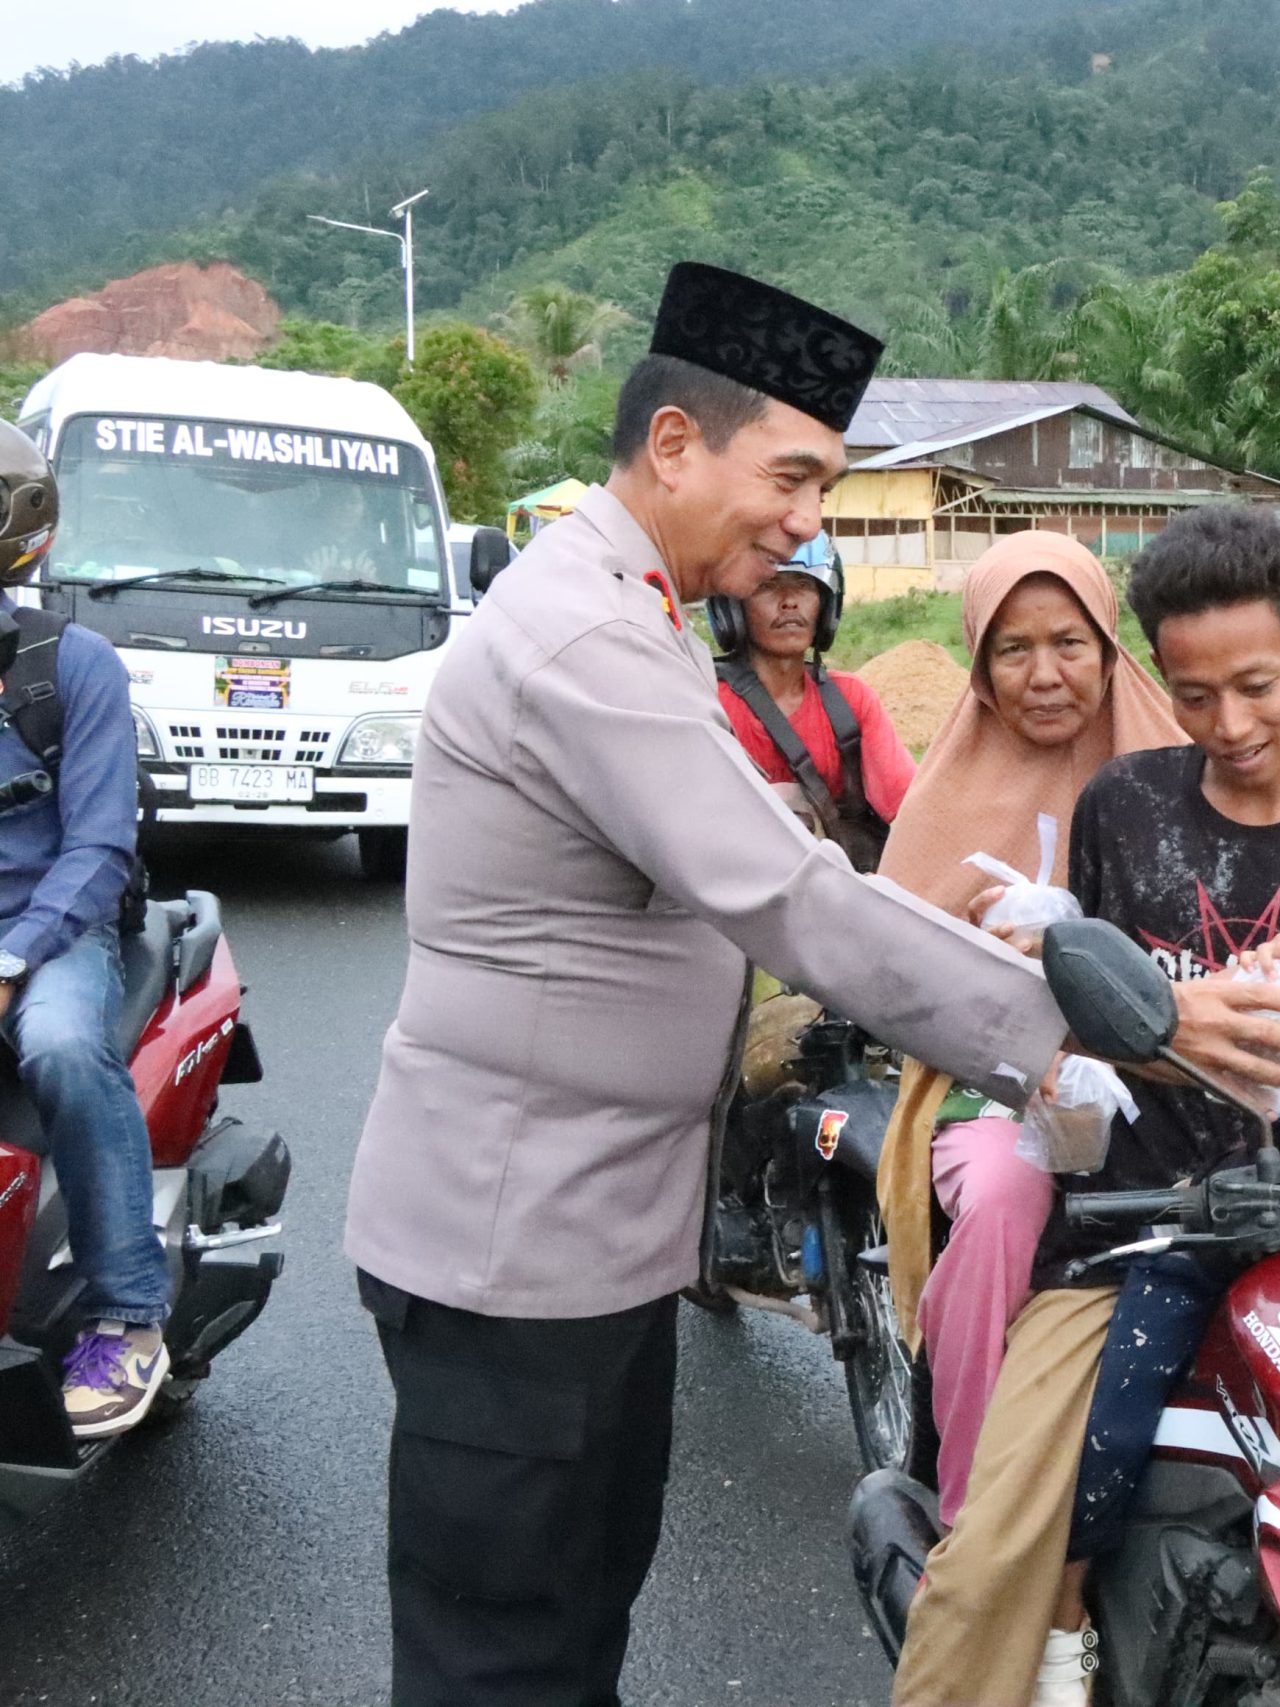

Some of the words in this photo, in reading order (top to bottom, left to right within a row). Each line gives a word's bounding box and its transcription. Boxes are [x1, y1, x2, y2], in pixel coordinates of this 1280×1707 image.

[96, 419, 165, 452] STIE
[172, 424, 399, 475] AL-WASHLIYAH
[202, 616, 307, 639] ISUZU
[198, 767, 220, 787] BB
[229, 768, 273, 788] 7423
[286, 770, 307, 789] MA
